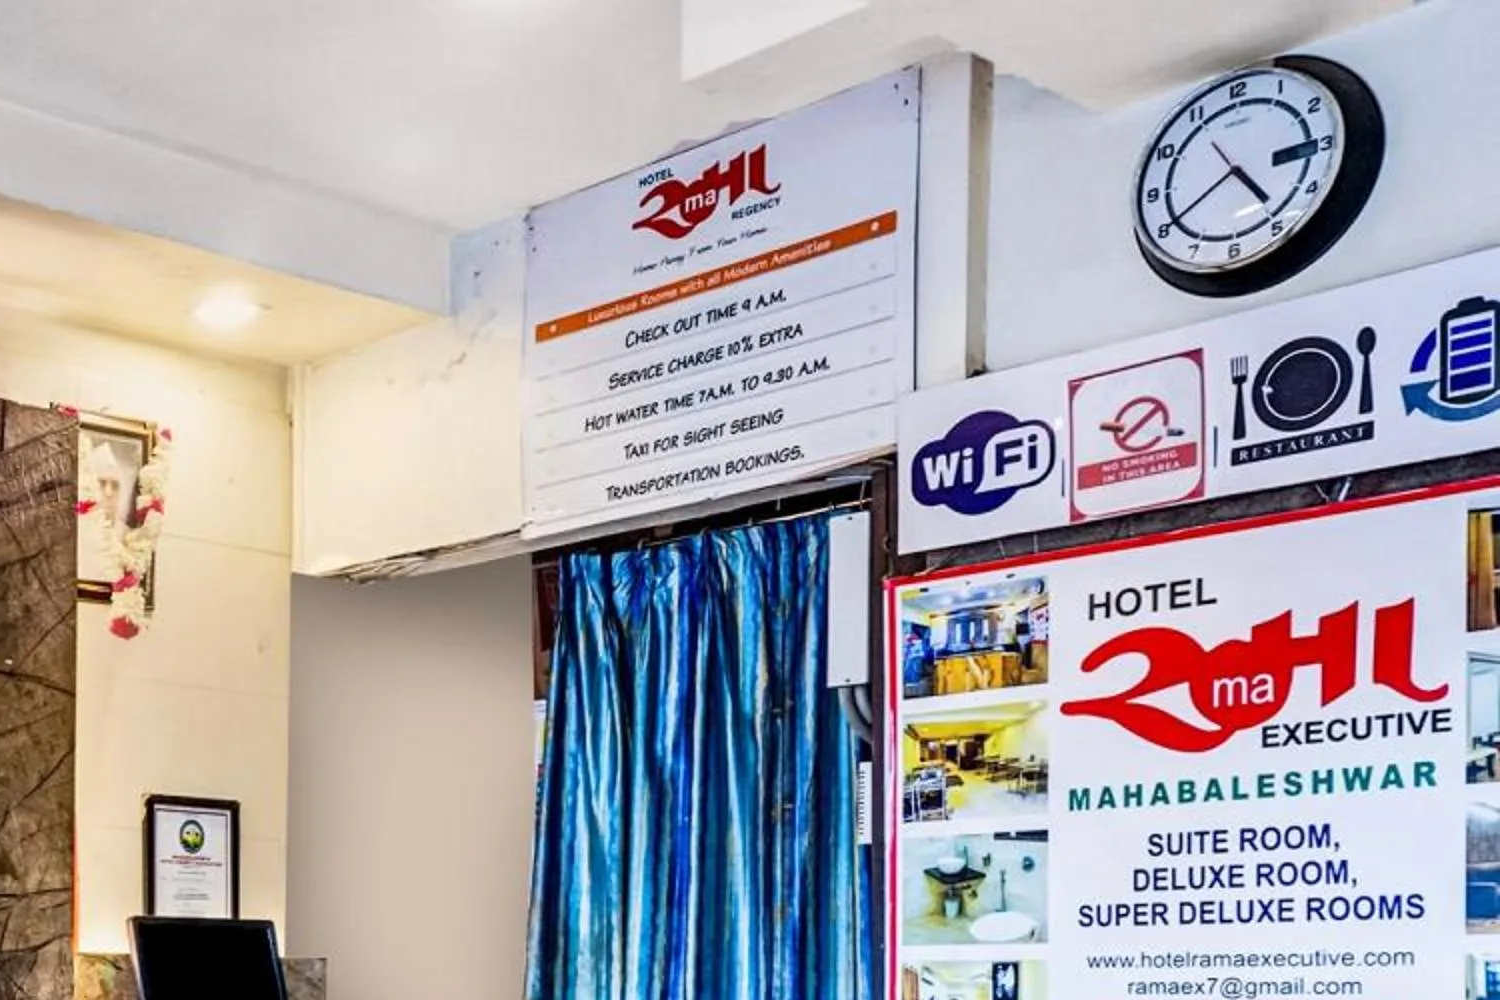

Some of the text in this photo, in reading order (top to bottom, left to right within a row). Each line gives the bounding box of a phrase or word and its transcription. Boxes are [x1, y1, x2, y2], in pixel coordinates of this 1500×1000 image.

[1229, 81, 1248, 98] 12
[1277, 79, 1284, 94] 1
[1189, 106, 1203, 122] 11
[1308, 97, 1321, 114] 2
[1156, 144, 1175, 162] 10
[1320, 135, 1333, 151] 3
[638, 167, 674, 188] HOTEL
[1305, 180, 1318, 195] 4
[1147, 188, 1159, 202] 9
[731, 197, 781, 220] REGENCY
[1157, 223, 1170, 239] 8
[1271, 220, 1283, 237] 5
[1188, 244, 1200, 259] 7
[1228, 243, 1240, 259] 6
[679, 278, 705, 295] with
[707, 274, 721, 286] all
[723, 258, 768, 281] Modern
[771, 239, 832, 267] Amenities
[625, 288, 787, 349] CHECK OUT TIME 9 A.M.
[608, 323, 803, 390] SERVICE CHARGE 10% EXTRA
[584, 410, 612, 432] HOT
[616, 401, 659, 424] WATER
[663, 390, 694, 413] TIME
[740, 375, 760, 392] TO
[763, 366, 793, 384] 9.30
[798, 356, 831, 377] A.M.
[623, 407, 785, 460] TAXI FOR SIGHT SEEING
[1238, 426, 1367, 462] RESTAURANT
[922, 433, 1040, 493] WiFi
[1101, 449, 1178, 472] NO SMOKING
[1103, 461, 1180, 482] IN THIS AREA
[606, 444, 805, 502] TRANSPORTATION BOOKINGS.
[1087, 577, 1217, 621] HOTEL
[1261, 708, 1453, 749] EXECUTIVE
[1068, 760, 1439, 811] MAHABALESHWAR
[1147, 823, 1341, 857] SUITE ROOM,
[1133, 859, 1358, 892] DELUXE ROOM,
[1078, 893, 1425, 927] SUPER DELUXE ROOMS
[1086, 949, 1416, 970] www.hotelramaexecutive.com
[1127, 977, 1363, 1000] ramaex7@gmail.com
